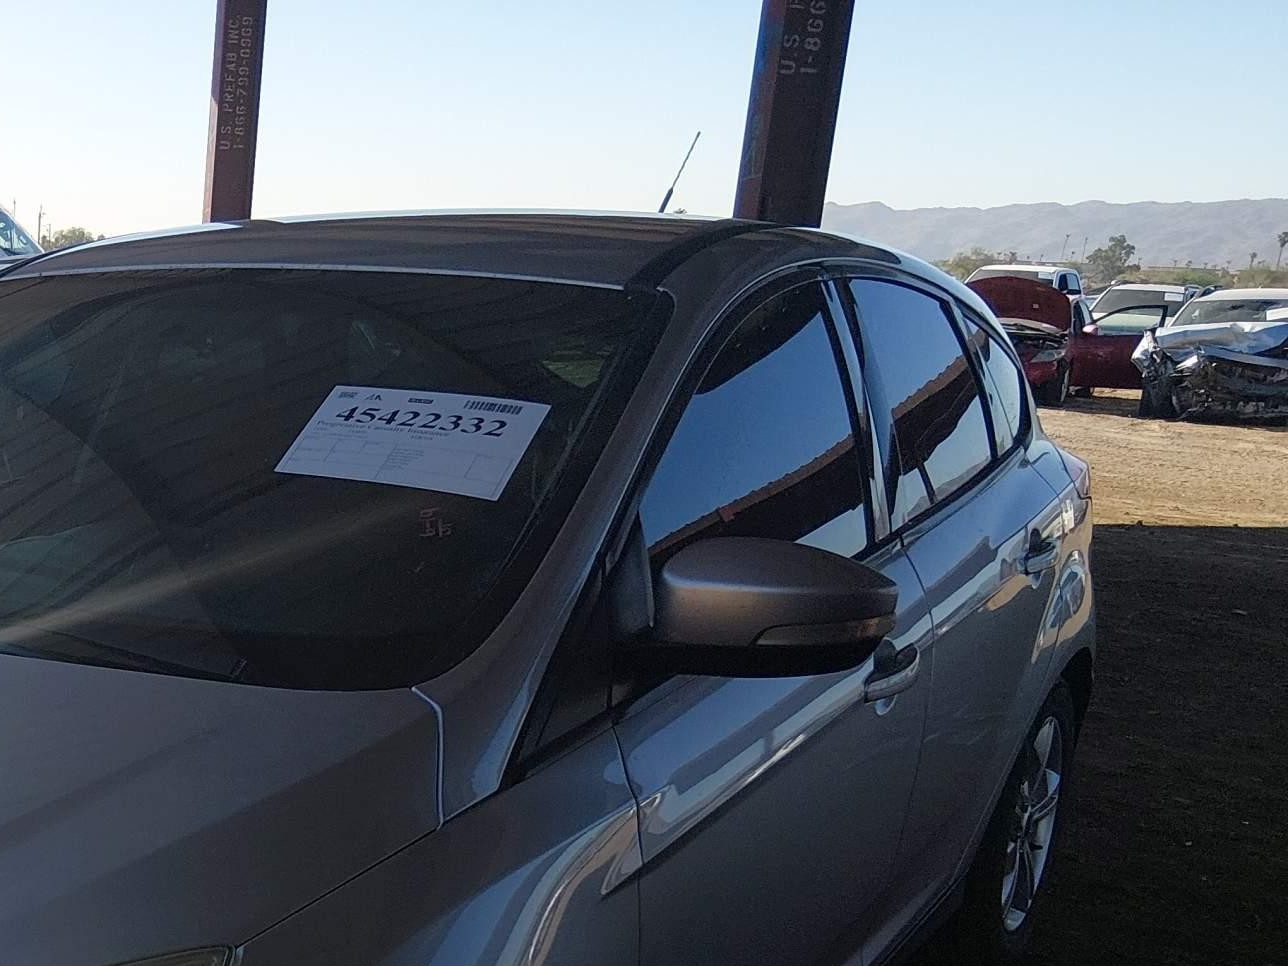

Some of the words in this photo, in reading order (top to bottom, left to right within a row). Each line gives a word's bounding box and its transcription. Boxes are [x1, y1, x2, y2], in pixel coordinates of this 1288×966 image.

[223, 52, 238, 112] PREFAB
[232, 15, 254, 150] 1-866-799-0969
[335, 405, 510, 438] 45422332
